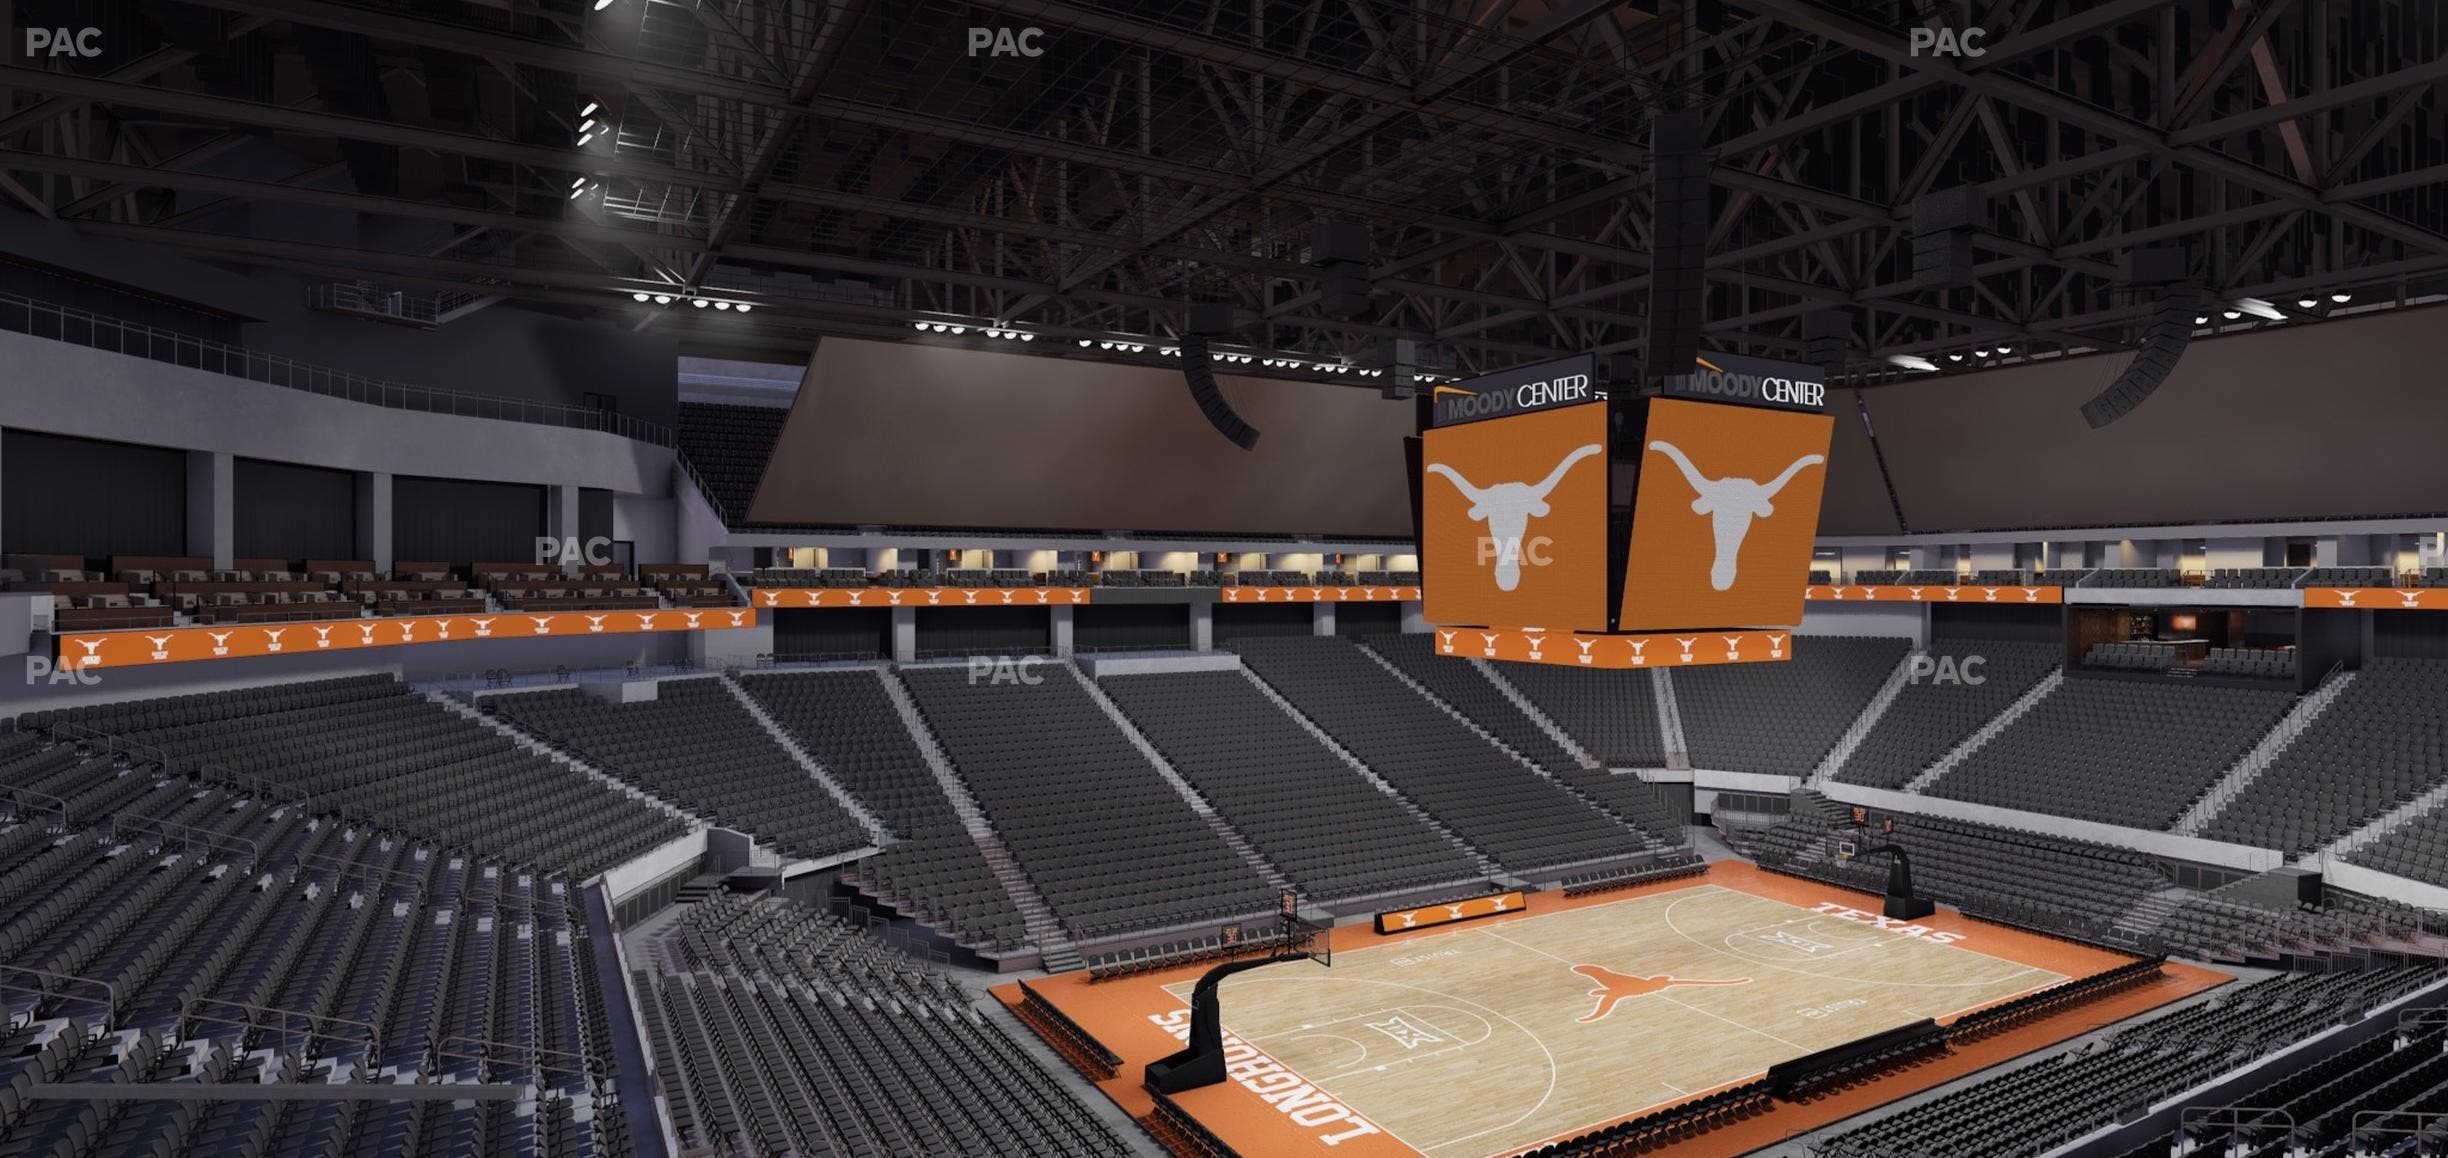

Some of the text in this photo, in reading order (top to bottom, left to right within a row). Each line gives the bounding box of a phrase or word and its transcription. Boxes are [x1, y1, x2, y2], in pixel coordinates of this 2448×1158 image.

[1450, 374, 1588, 420] MOODY CENTER
[1690, 368, 1825, 406] MOODY CENTER
[1810, 902, 1967, 944] TEXAS
